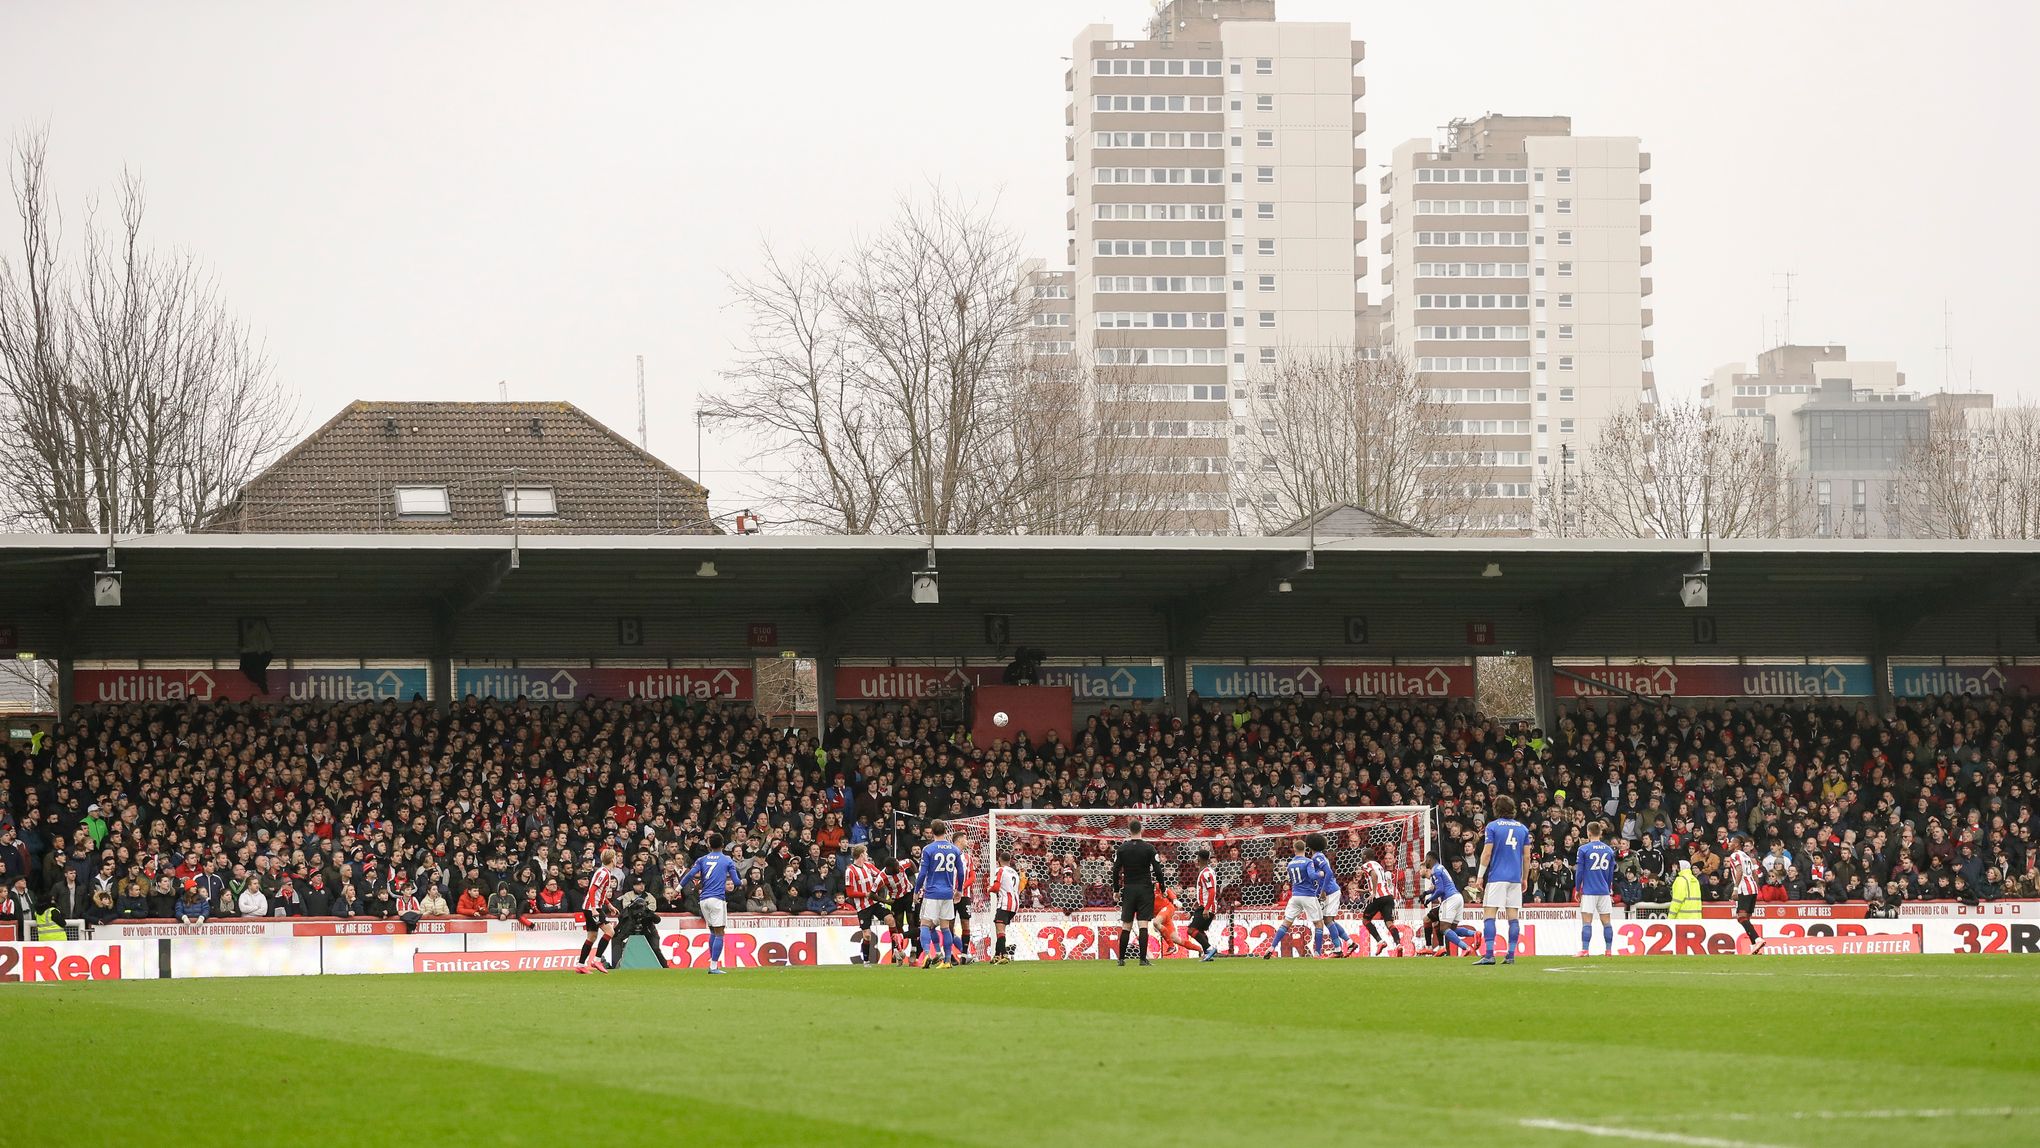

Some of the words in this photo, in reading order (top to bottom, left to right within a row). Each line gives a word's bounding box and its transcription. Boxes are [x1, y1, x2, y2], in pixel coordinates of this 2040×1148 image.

[622, 618, 639, 645] B
[1697, 617, 1713, 643] D
[99, 675, 186, 701] utilita
[290, 675, 374, 701] utilita
[465, 674, 549, 700] utilita
[628, 674, 712, 700] utilita
[861, 673, 942, 697] utilita
[1039, 672, 1110, 697] tilita
[1216, 671, 1297, 696] utilita
[1345, 671, 1424, 696] utilita
[1573, 671, 1652, 696] utilita
[1743, 671, 1822, 696] utilita
[1904, 672, 1981, 697] utilita
[1505, 829, 1518, 850] 4
[705, 861, 718, 880] 7
[934, 852, 956, 873] 28
[1589, 852, 1610, 871] 26
[1290, 867, 1303, 883] 11
[1462, 911, 1474, 920] OUR
[1526, 910, 1577, 920] BRENTFORDFC.COM
[1798, 907, 1807, 917] WE
[1807, 907, 1818, 917] ARE
[1818, 907, 1832, 917] BEES
[1901, 906, 1932, 915] BRENTFORD
[1933, 906, 1940, 915] FC
[1941, 905, 1949, 914] ON
[122, 927, 135, 937] BUY
[136, 926, 153, 937] YOUR
[153, 926, 177, 936] TICKETS
[178, 925, 201, 936] ONLINE
[200, 925, 209, 936] AT
[209, 925, 265, 936] BRENTFORDFC.COM
[335, 923, 346, 934] WE
[346, 923, 357, 934] ARE
[357, 923, 373, 934] BEES
[418, 923, 430, 933] ARE
[430, 923, 446, 933] BEES
[511, 922, 525, 931] FIND
[560, 921, 568, 930] FC
[568, 921, 577, 930] ON
[735, 919, 759, 928] TICKETS
[759, 918, 781, 928] ONLINE
[781, 918, 789, 927] AT
[789, 918, 843, 928] BRENTFORDFC.COM
[662, 931, 818, 969] 32Red
[1762, 943, 1835, 955] mirates
[1842, 942, 1863, 954] FLY
[1866, 940, 1910, 954] BETTER
[421, 958, 510, 972] Emirates
[518, 957, 541, 969] FLY
[542, 955, 588, 969] BETTE
